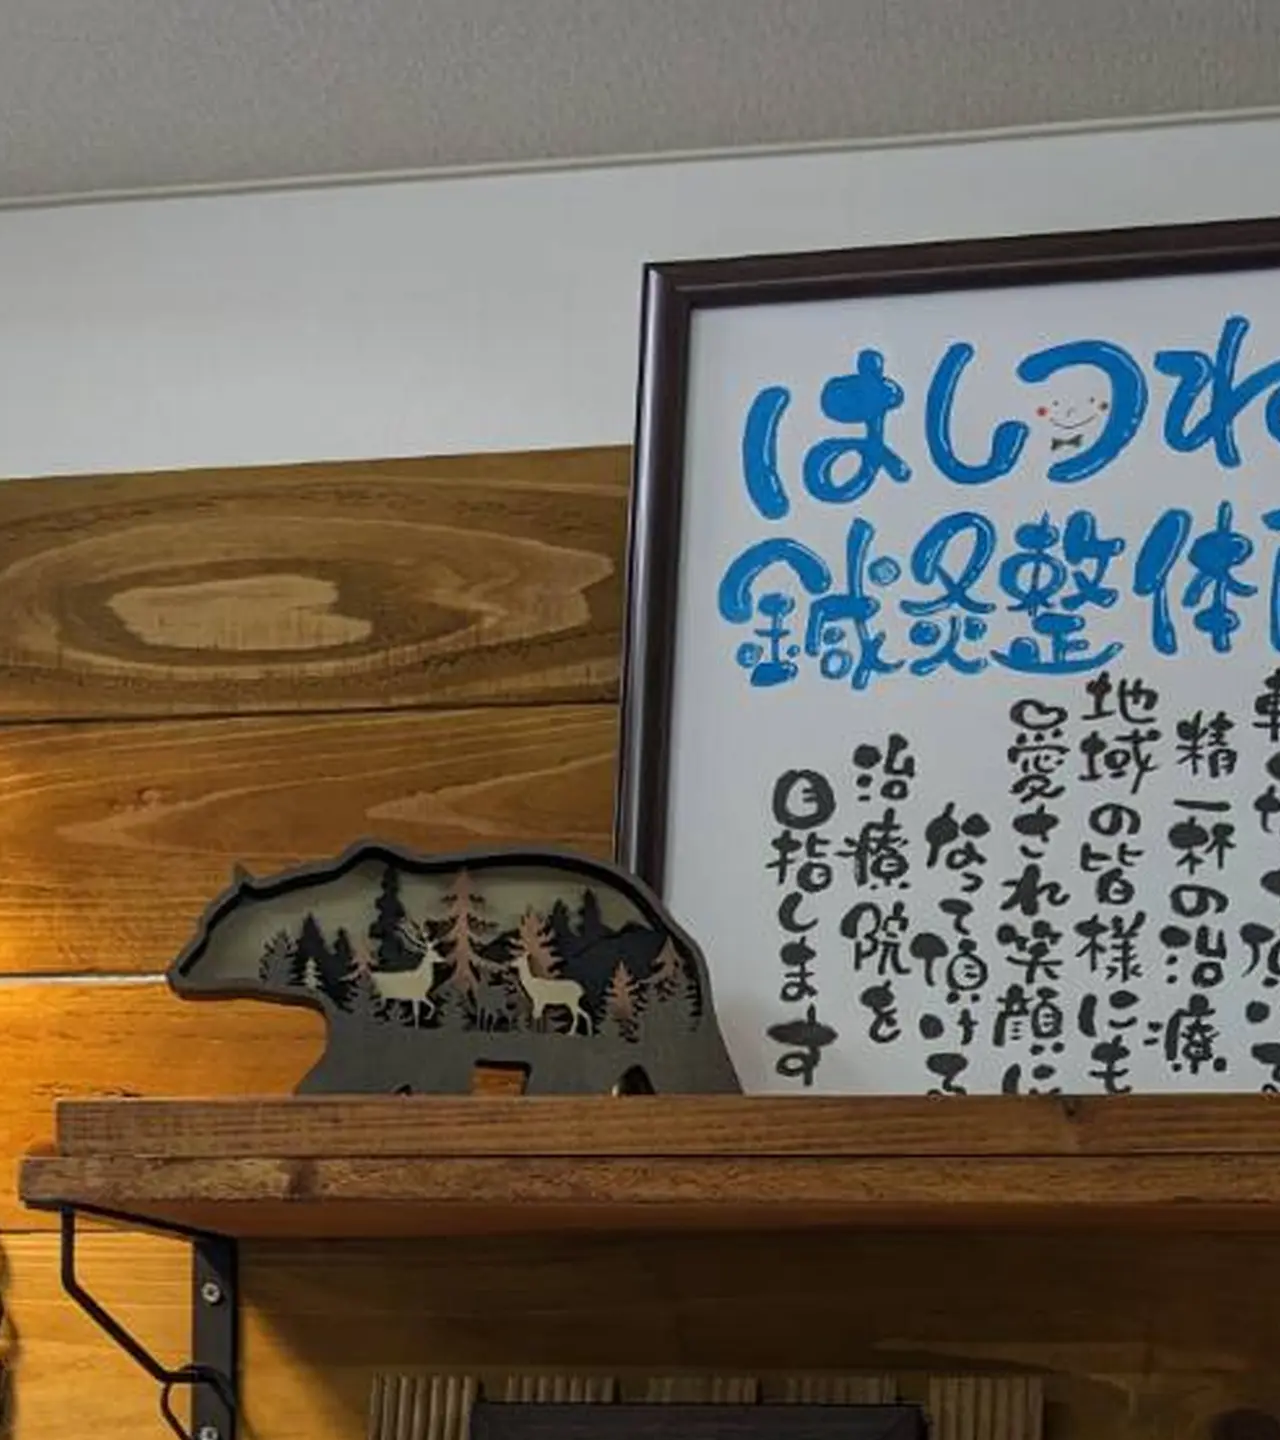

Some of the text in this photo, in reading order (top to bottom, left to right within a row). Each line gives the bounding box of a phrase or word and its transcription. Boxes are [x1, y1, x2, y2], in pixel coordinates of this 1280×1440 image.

[765, 768, 839, 1088] 目指します
[837, 732, 916, 1045] 治療院を
[910, 802, 992, 1095] なって頂ける
[991, 698, 1071, 1094] 愛され笑顔に
[1072, 670, 1161, 1094] 地域の皆様にも
[1142, 709, 1238, 1076] 精一杯の治療
